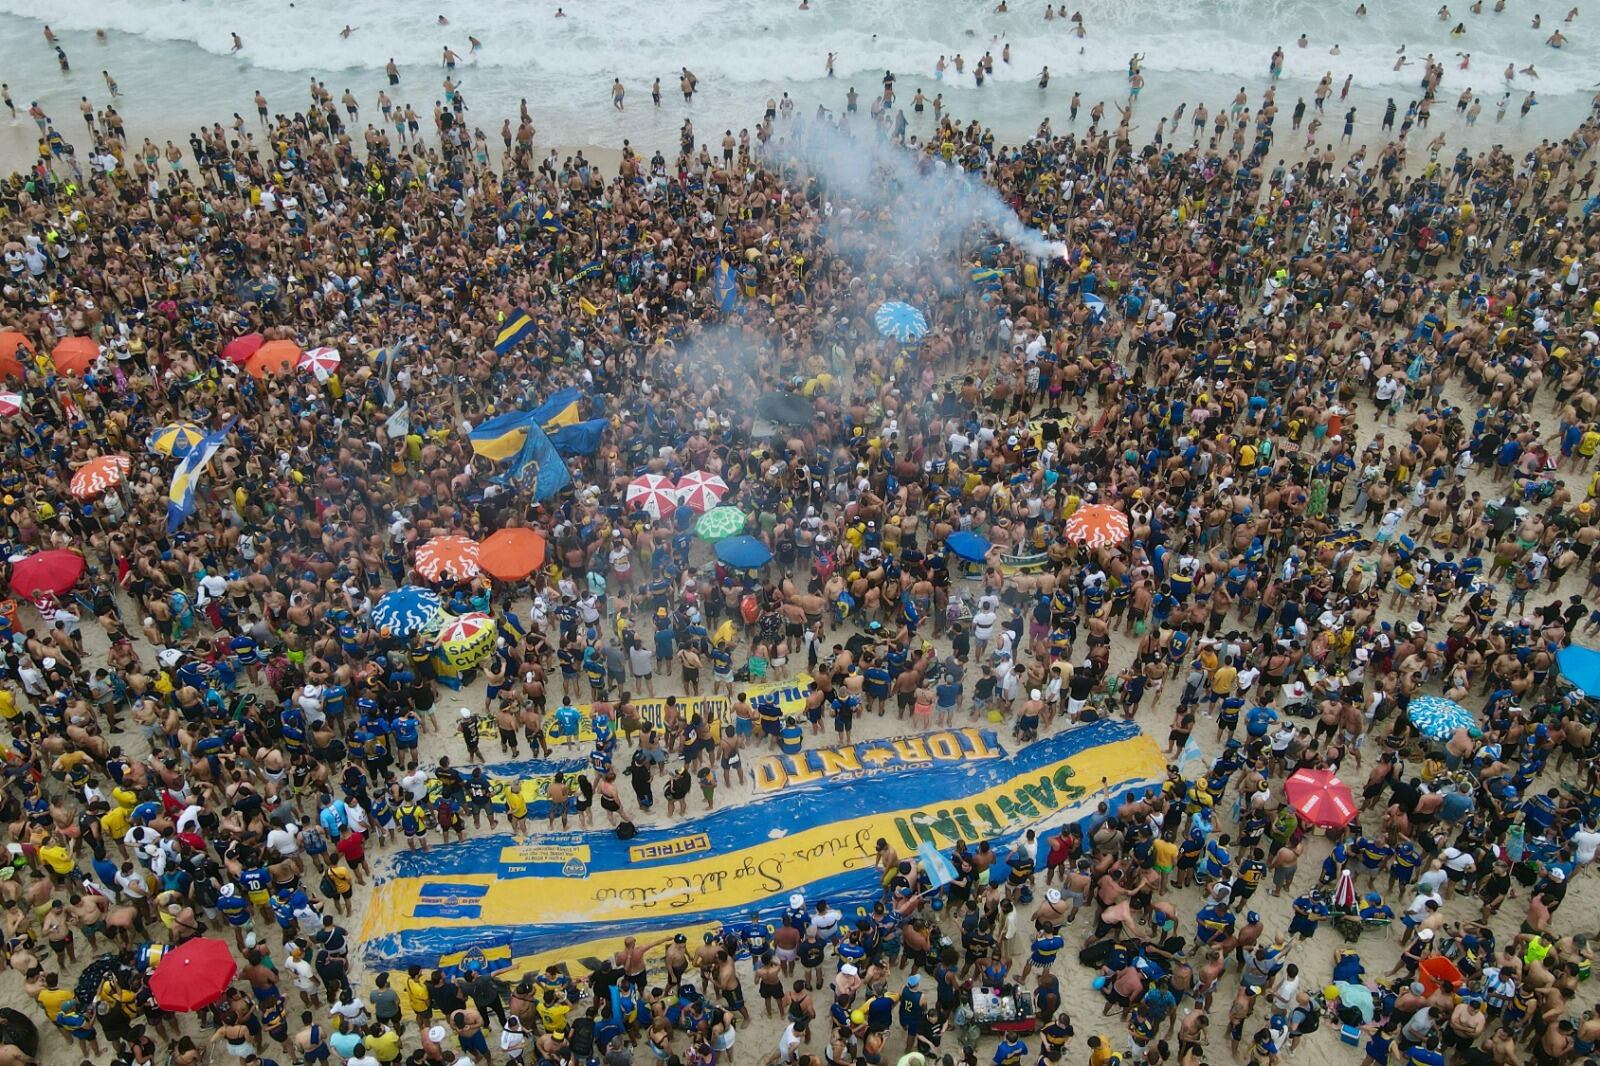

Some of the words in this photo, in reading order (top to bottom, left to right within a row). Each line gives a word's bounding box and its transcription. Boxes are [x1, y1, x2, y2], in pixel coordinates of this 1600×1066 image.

[448, 629, 493, 656] SANTA
[1173, 639, 1183, 650] 12
[754, 728, 1000, 793] TORNTO
[894, 765, 1086, 851] SANTINI
[633, 837, 707, 859] CATRIEL
[248, 880, 260, 890] 10
[904, 999, 913, 1013] 12
